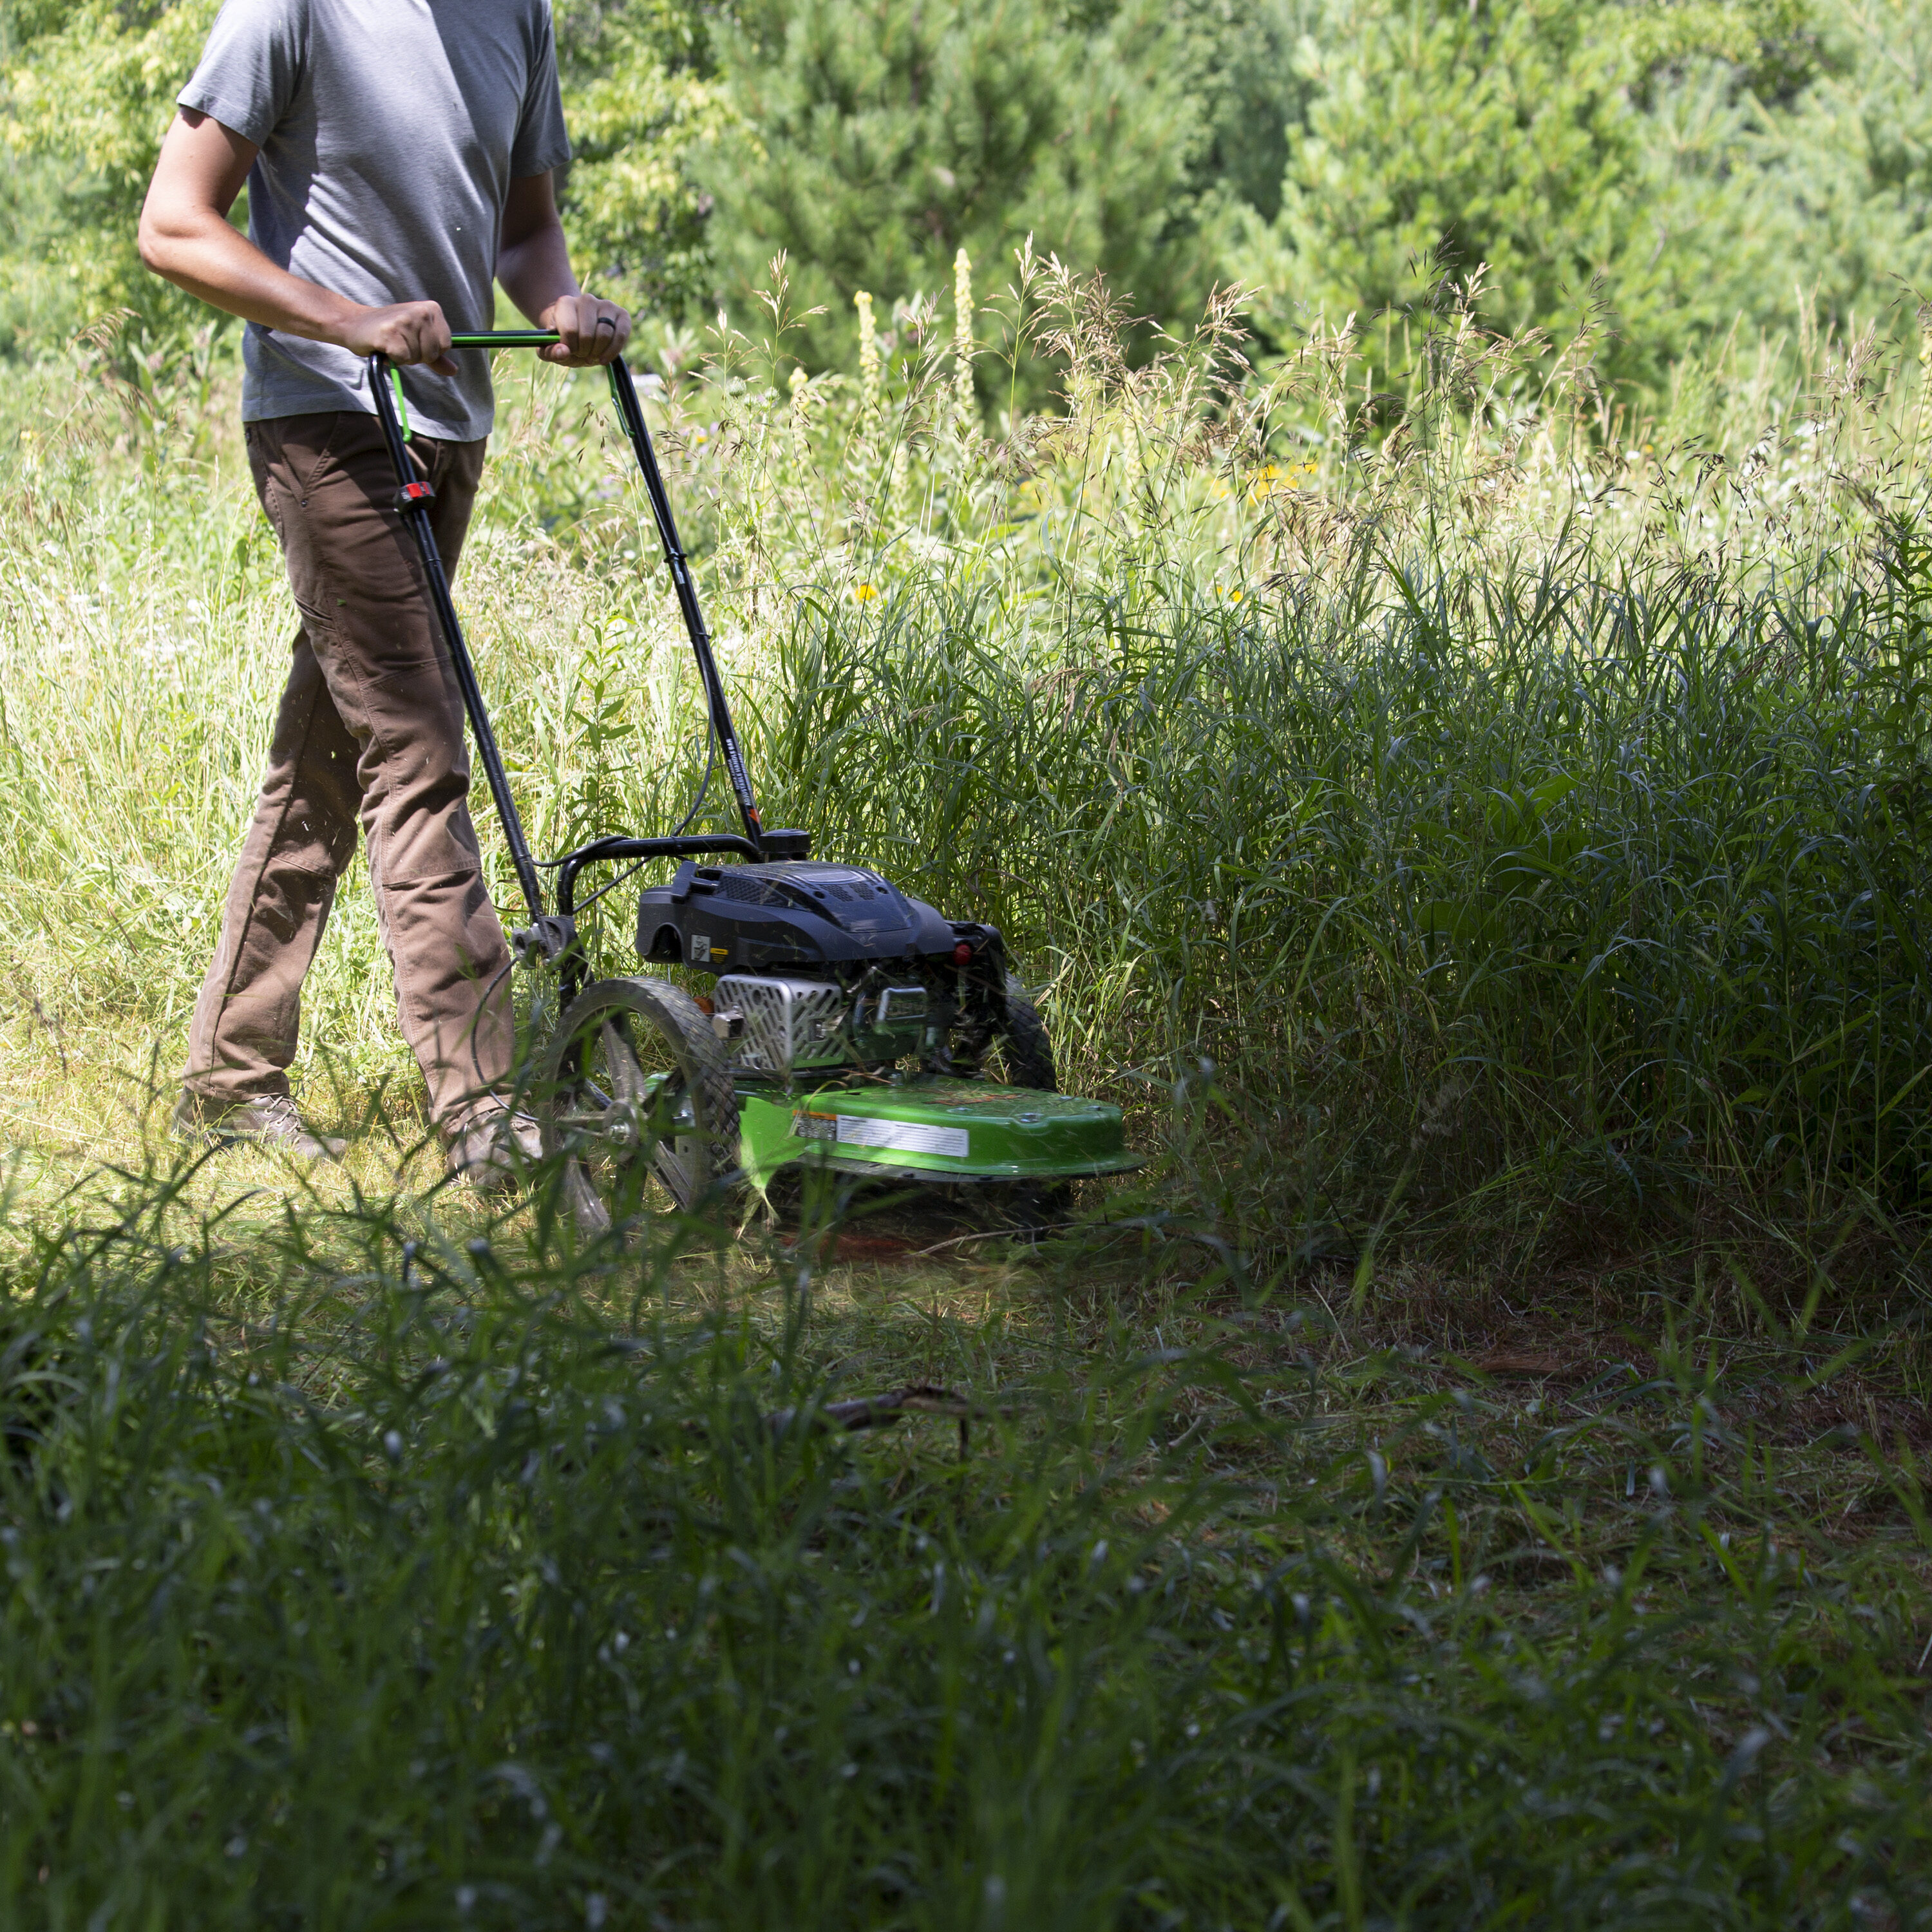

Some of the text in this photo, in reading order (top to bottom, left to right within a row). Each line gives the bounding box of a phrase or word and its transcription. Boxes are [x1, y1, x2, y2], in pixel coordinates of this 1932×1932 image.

[726, 739, 735, 750] BAR
[730, 750, 742, 773] HANDLE
[736, 773, 752, 806] ADJUSTABLE
